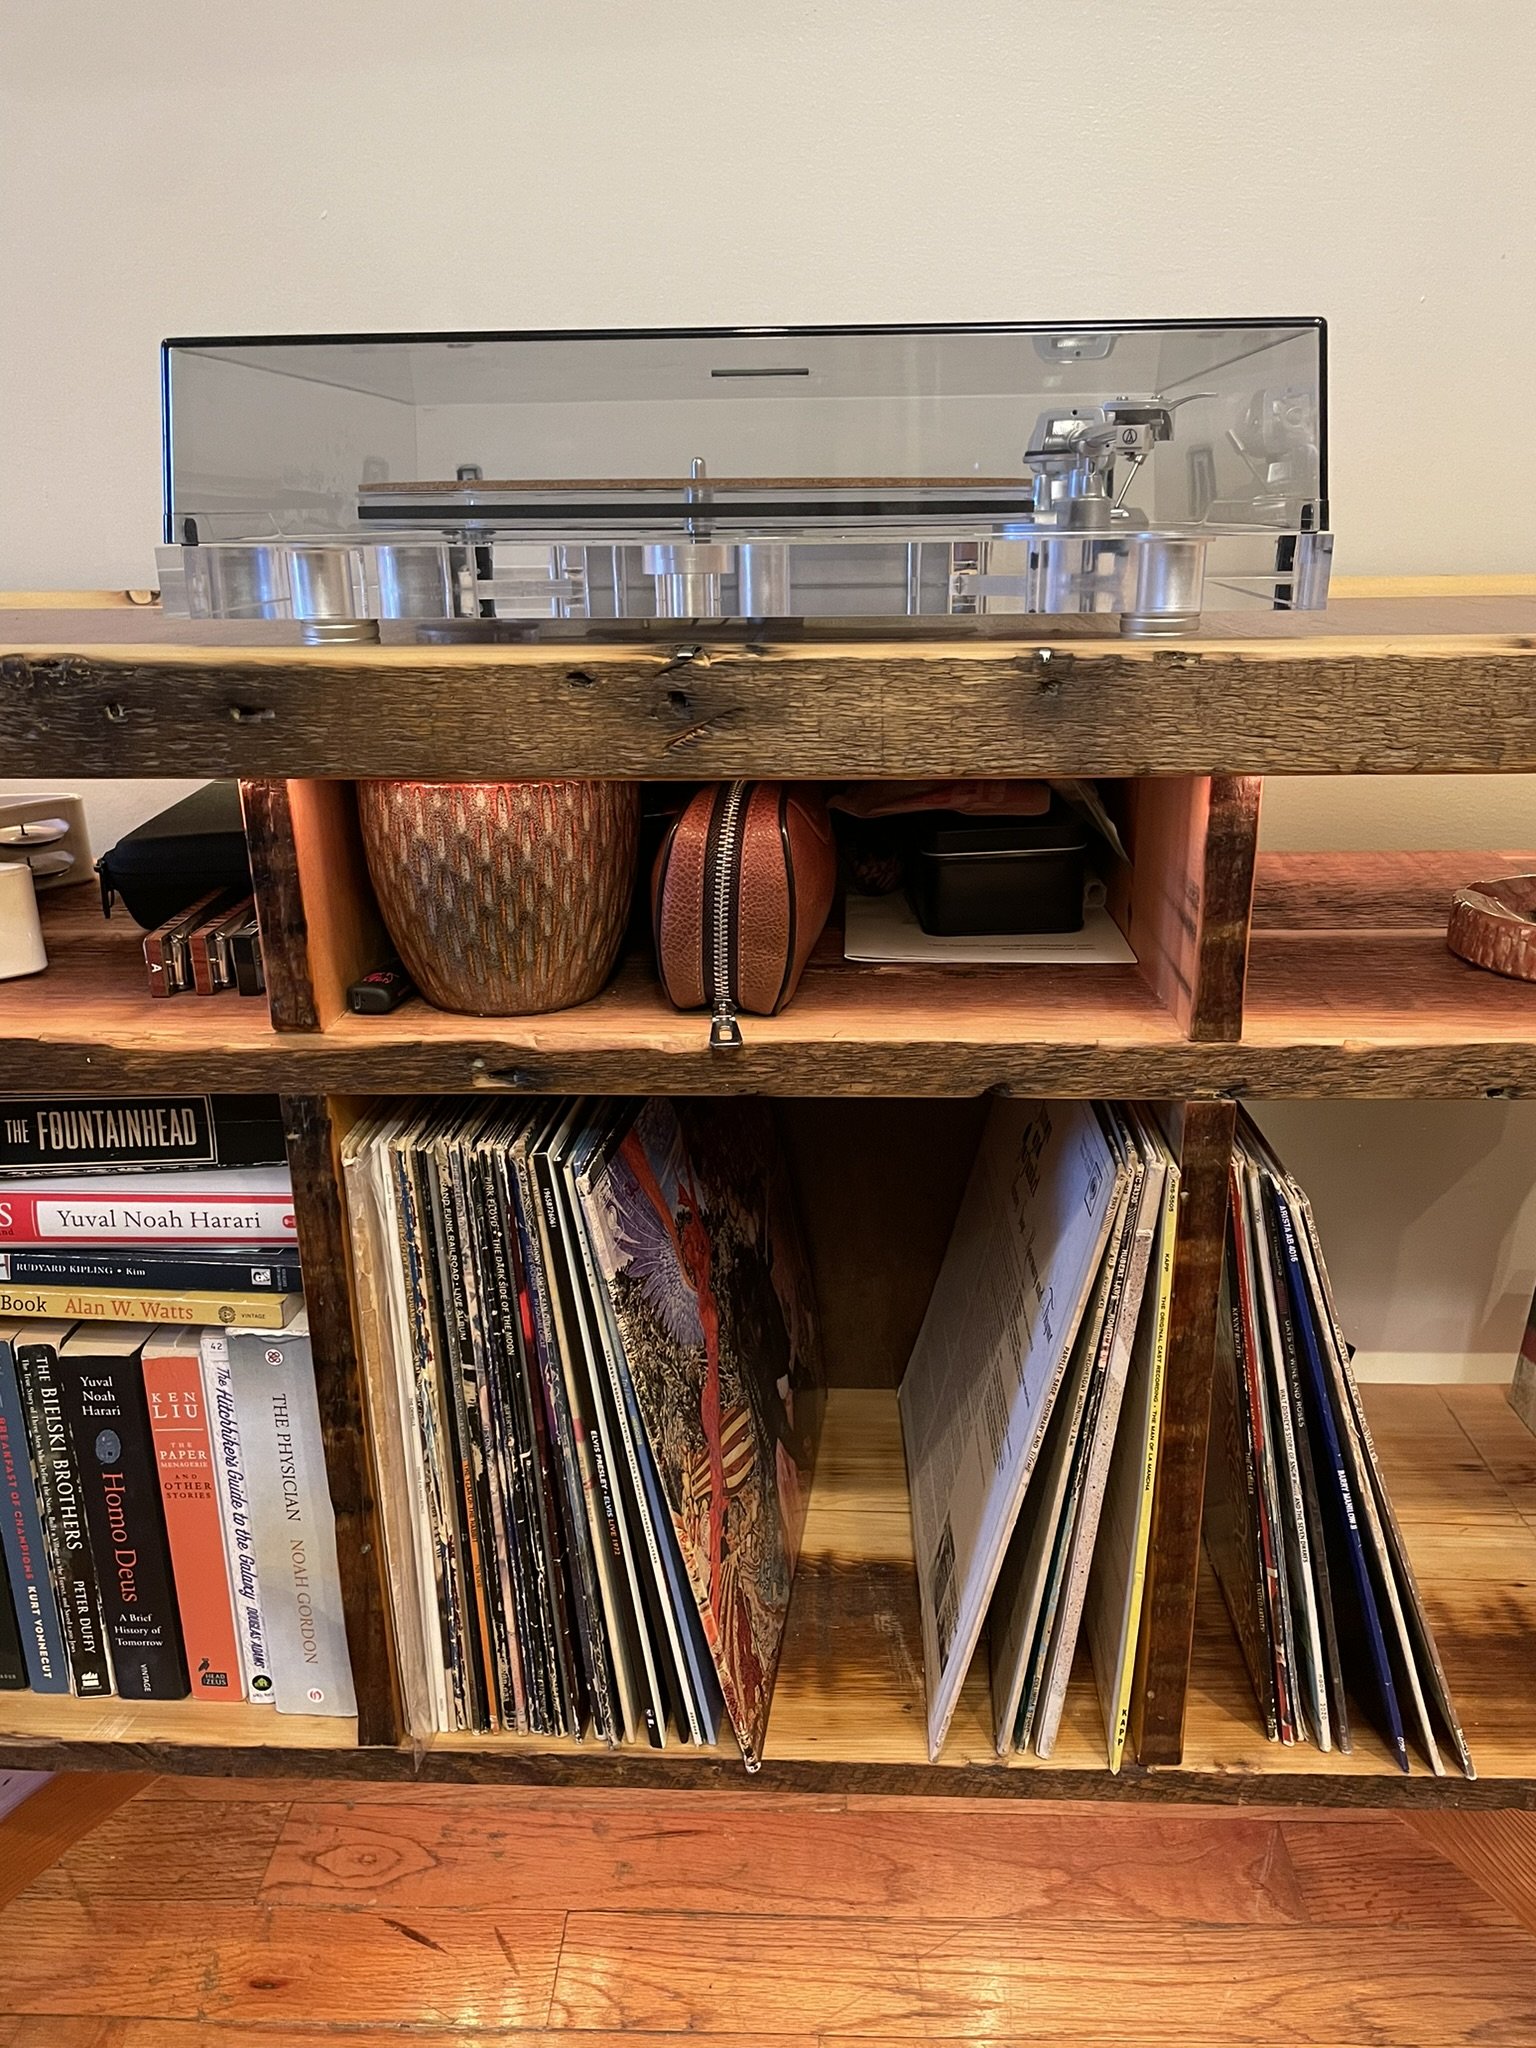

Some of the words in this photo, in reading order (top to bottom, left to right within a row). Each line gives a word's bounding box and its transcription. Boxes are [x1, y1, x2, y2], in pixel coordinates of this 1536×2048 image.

[5, 1120, 30, 1144] THE
[36, 1108, 198, 1150] FOUNTAINHEAD
[483, 1175, 493, 1196] PINK
[57, 1210, 116, 1229] Yuval
[124, 1210, 183, 1228] Noah
[190, 1211, 262, 1229] Harari
[444, 1207, 453, 1233] FUNK
[486, 1197, 497, 1227] FLOYD
[1278, 1204, 1291, 1233] ARISTA
[492, 1237, 501, 1254] THE
[1284, 1231, 1294, 1245] AB
[447, 1234, 461, 1281] RAILROAD
[525, 1244, 533, 1264] STEVIE
[531, 1236, 541, 1265] JOHNNY
[1287, 1244, 1298, 1263] 4016
[16, 1263, 66, 1274] RUDYARD
[69, 1264, 114, 1275] KIPLING
[126, 1267, 146, 1276] Kim
[494, 1254, 505, 1280] DARK
[1115, 1248, 1128, 1277] HUBERT
[527, 1263, 537, 1290] WONDER
[535, 1265, 543, 1286] CASH
[454, 1287, 464, 1308] LIVE
[497, 1280, 508, 1300] SIDE
[0, 1294, 47, 1313] Book
[64, 1298, 105, 1316] Alan
[113, 1300, 135, 1318] W.
[141, 1302, 194, 1320] Watts
[500, 1299, 509, 1312] OF
[456, 1308, 468, 1341] ALBUM
[502, 1312, 512, 1330] THE
[1156, 1311, 1164, 1342] ORIGINAL
[1284, 1319, 1292, 1342] DAYS
[504, 1329, 515, 1356] MOON
[1287, 1343, 1295, 1355] OF
[36, 1356, 51, 1382] THE
[216, 1367, 232, 1387] The
[1079, 1351, 1093, 1392] WEDNESDAY
[1289, 1357, 1297, 1379] WINE
[80, 1376, 113, 1387] Yuval
[1152, 1364, 1160, 1403] RECORDING
[1292, 1380, 1301, 1399] AND
[82, 1390, 116, 1402] Noah
[151, 1391, 196, 1403] KEN
[1279, 1388, 1287, 1405] WALT
[40, 1387, 67, 1452] BIELSKI
[82, 1405, 121, 1416] Harari
[152, 1404, 199, 1419] LIU
[272, 1393, 290, 1428] THE
[1036, 1398, 1053, 1433] ROSEMARY
[1281, 1405, 1291, 1432] DISNEY'S
[1295, 1400, 1305, 1428] ROSES
[216, 1387, 241, 1468] Hitchhiker's
[589, 1429, 600, 1453] ELVIS
[1032, 1433, 1041, 1449] AND
[1148, 1441, 1154, 1450] OF
[1285, 1432, 1293, 1451] STORY
[159, 1450, 208, 1460] PAPER
[1146, 1452, 1153, 1461] LA
[1288, 1451, 1294, 1461] OF
[277, 1433, 301, 1522] PHYSICIAN
[593, 1452, 608, 1490] PRESLEY
[1144, 1462, 1152, 1492] MANCHA
[1336, 1468, 1349, 1493] BARRY
[164, 1482, 212, 1490] OTHER
[227, 1469, 249, 1511] Guide
[10, 1491, 21, 1506] OF
[53, 1459, 83, 1550] BROTHERS
[602, 1494, 613, 1518] ELVIS
[1293, 1496, 1301, 1510] AND
[1342, 1491, 1357, 1525] MANILOW
[233, 1513, 249, 1526] to
[607, 1517, 617, 1537] LIVE
[1296, 1521, 1304, 1540] SEVEN
[102, 1472, 127, 1543] Homo
[115, 1549, 138, 1602] Deus
[236, 1528, 253, 1550] the
[611, 1538, 620, 1556] 1972
[290, 1539, 309, 1588] NOAH
[1298, 1540, 1308, 1564] DWARFS
[239, 1554, 259, 1601] Galaxy
[27, 1585, 41, 1615] KURT
[73, 1580, 89, 1614] PETER
[130, 1613, 153, 1622] Brief
[246, 1606, 261, 1642] DOUGLAS
[296, 1592, 319, 1665] GORDON
[79, 1618, 96, 1654] DUFFY
[115, 1626, 149, 1635] History
[151, 1625, 163, 1634] of
[115, 1637, 164, 1647] Tomorrow
[250, 1641, 265, 1668] ADAMS
[140, 1663, 152, 1692] VINTAGE
[1117, 1708, 1128, 1746] KAPP
